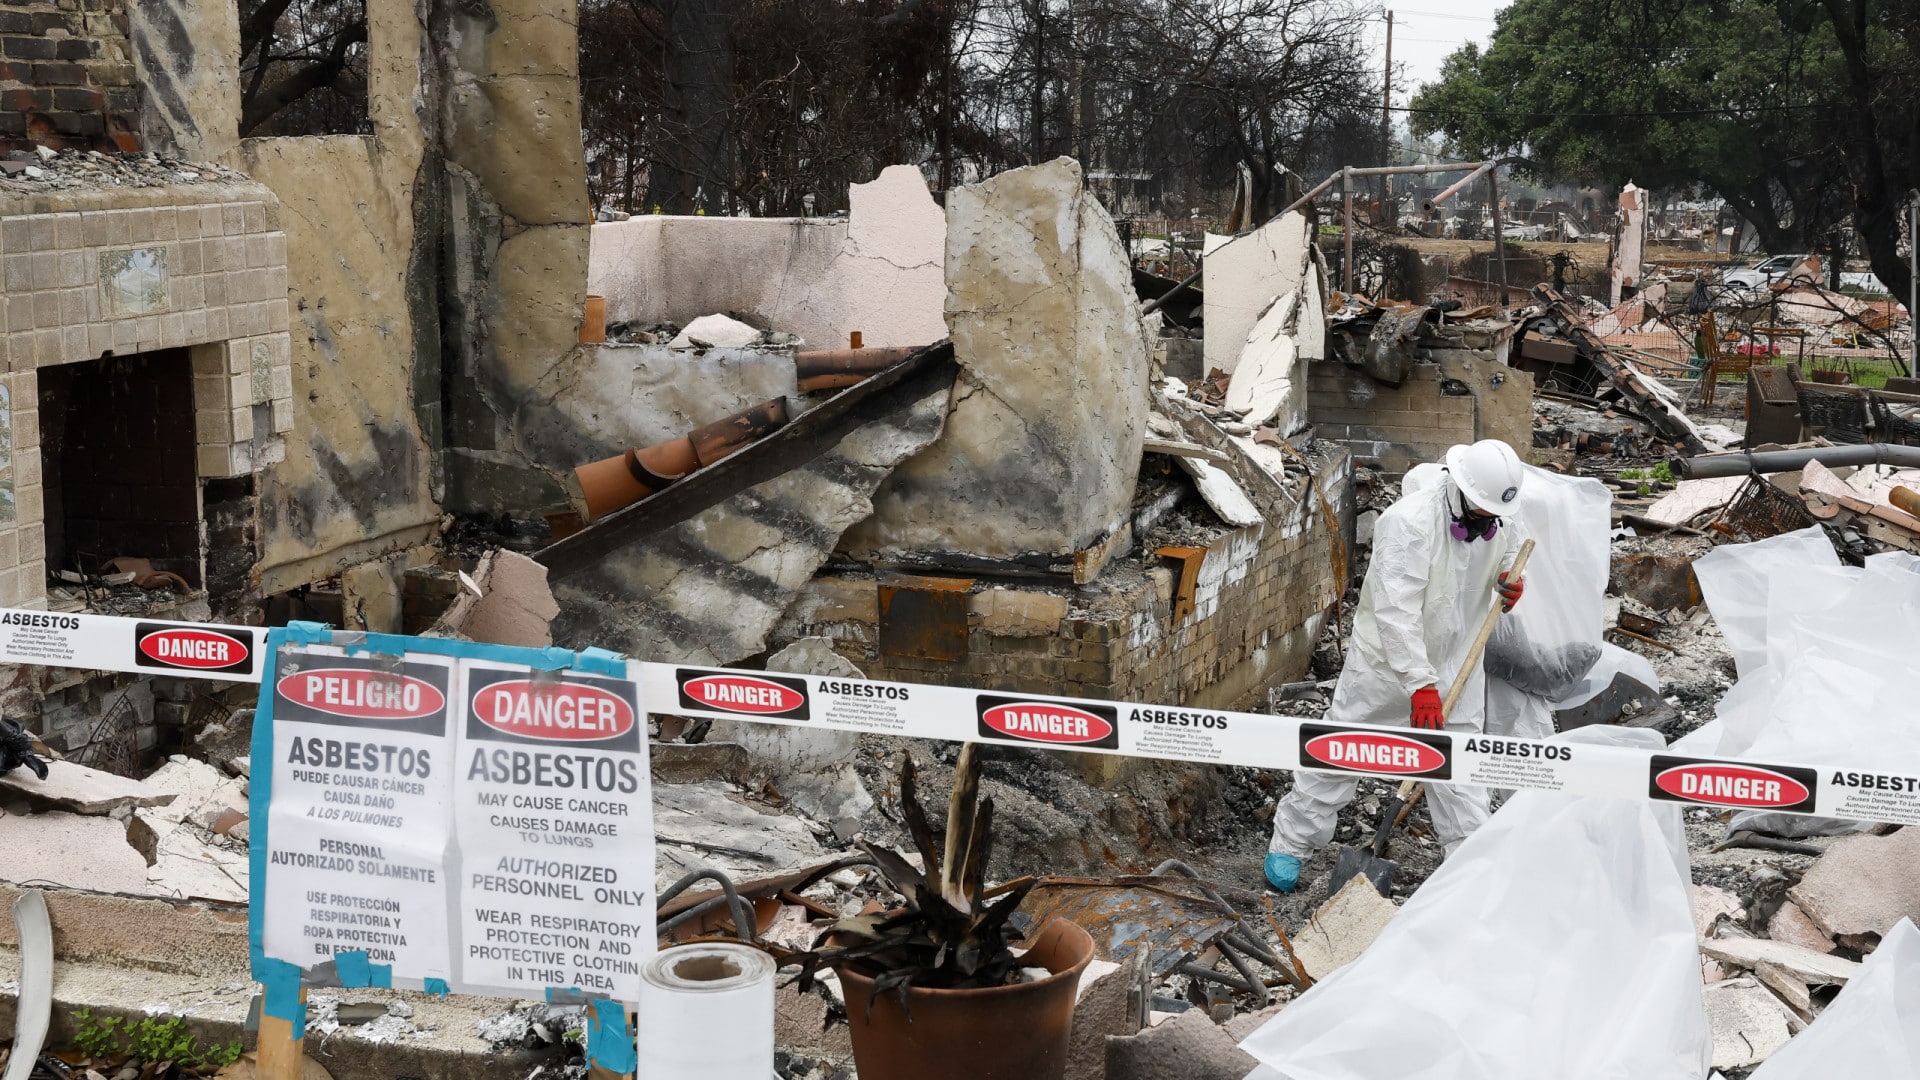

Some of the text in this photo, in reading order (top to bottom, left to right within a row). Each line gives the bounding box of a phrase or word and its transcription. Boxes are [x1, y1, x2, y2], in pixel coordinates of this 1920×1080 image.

[2, 613, 79, 629] ASBESTOS
[158, 637, 228, 661] DANGER
[307, 676, 420, 711] PELIGRO
[703, 683, 783, 707] DANGER
[819, 681, 909, 700] ASBESTOS
[494, 690, 617, 732] DANGER
[1130, 709, 1227, 729] ASBESTOS
[1004, 711, 1089, 737] DANGER
[288, 736, 430, 778] ASBESTOS
[1329, 740, 1419, 768] DANGER
[1464, 738, 1571, 761] ASBESTOS
[293, 770, 424, 795] PUEDE CAUSAR CÁNCER
[468, 748, 638, 794] ASBESTOS
[1831, 771, 1920, 792] ASBEST
[1681, 773, 1780, 801] DANGER
[324, 791, 394, 809] CAUSA DAÑO
[478, 792, 628, 816] MAY CAUSE CANCER
[307, 806, 403, 828] A LOS PULMONES
[491, 816, 618, 836] CAUSES DAMAGE
[320, 839, 386, 860] PERSONAL
[519, 832, 594, 848] TO LUNGS
[272, 851, 435, 883] AUTORIZADO SOLAMENTE
[497, 856, 617, 884] AUTHORIZED
[307, 891, 400, 913] USE PROTECCIÓN
[473, 874, 645, 906] PERSONNEL ONLY
[311, 909, 401, 929] RESPIRATORIA Y
[476, 909, 641, 938] WEAR RESPIRATORY
[304, 926, 407, 946] ROPA PROTECTIVA
[487, 928, 631, 956] PROTECTION AND
[315, 944, 329, 955] EN
[366, 948, 396, 961] ZONA
[470, 946, 638, 975] PROTECTIVE CLOTHIN
[508, 967, 614, 990] IN THIS AREA
